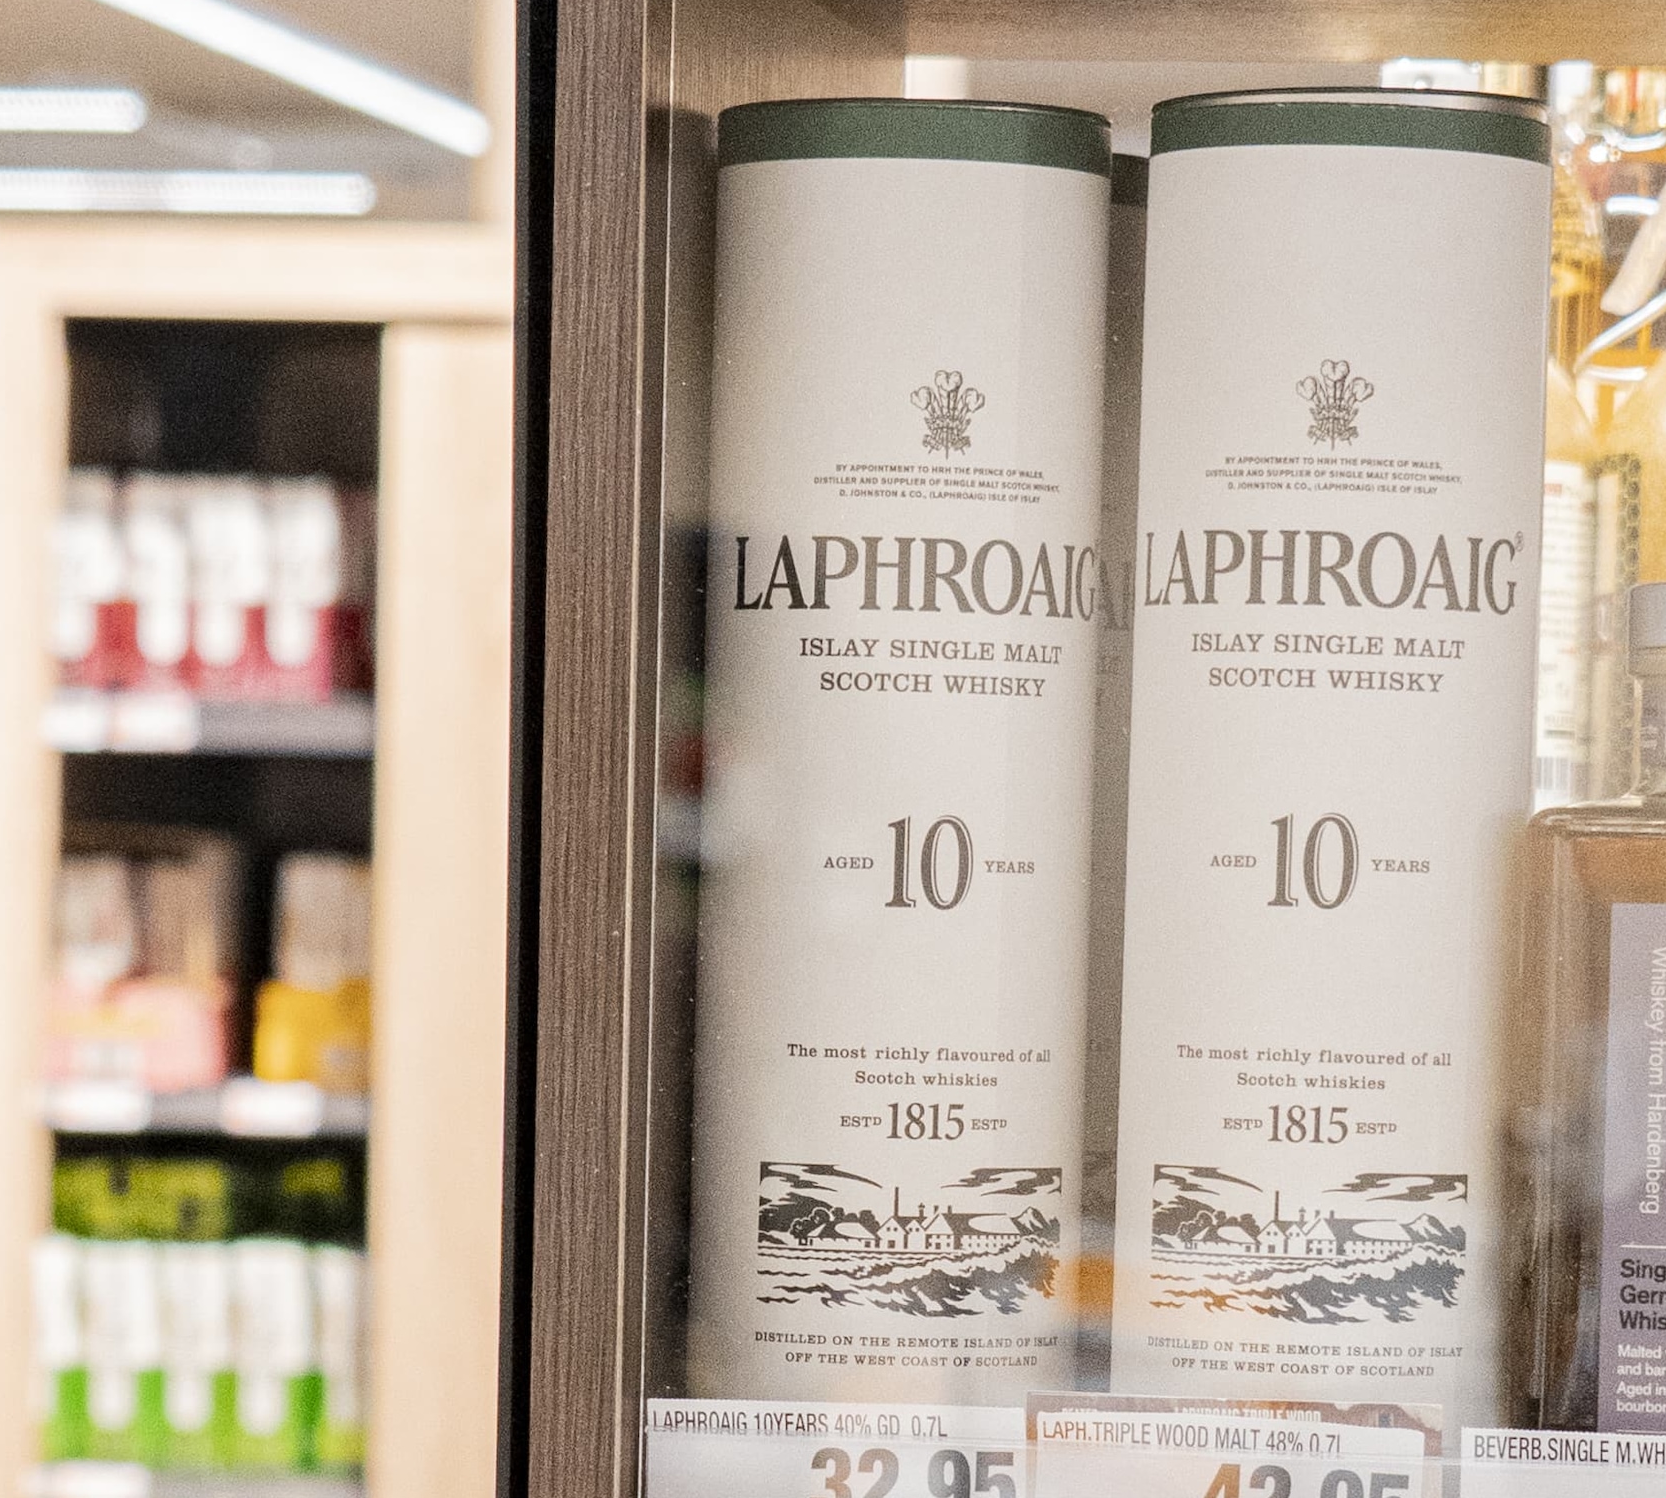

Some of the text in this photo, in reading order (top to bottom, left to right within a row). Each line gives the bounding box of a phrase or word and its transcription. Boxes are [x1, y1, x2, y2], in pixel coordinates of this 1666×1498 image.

[735, 535, 1095, 622] LAPHROAIG
[1144, 529, 1518, 616] LAPHROAIG
[799, 637, 1062, 665] ISLAY SINGLE MALT
[820, 672, 1046, 697] SCOTCH WHISKY
[824, 815, 1035, 911] AGED 10 YEARS
[1268, 812, 1359, 909] 10
[787, 1044, 1050, 1063] The most richly flavoured of all
[855, 1071, 998, 1087] Scotch whiskies
[887, 1102, 965, 1140] 1815
[1268, 1105, 1348, 1144] 1815
[1043, 1421, 1303, 1452] LAPH.TRIPLE WOOD MALT 48%
[1474, 1436, 1609, 1463] BEVERB.SINGLE
